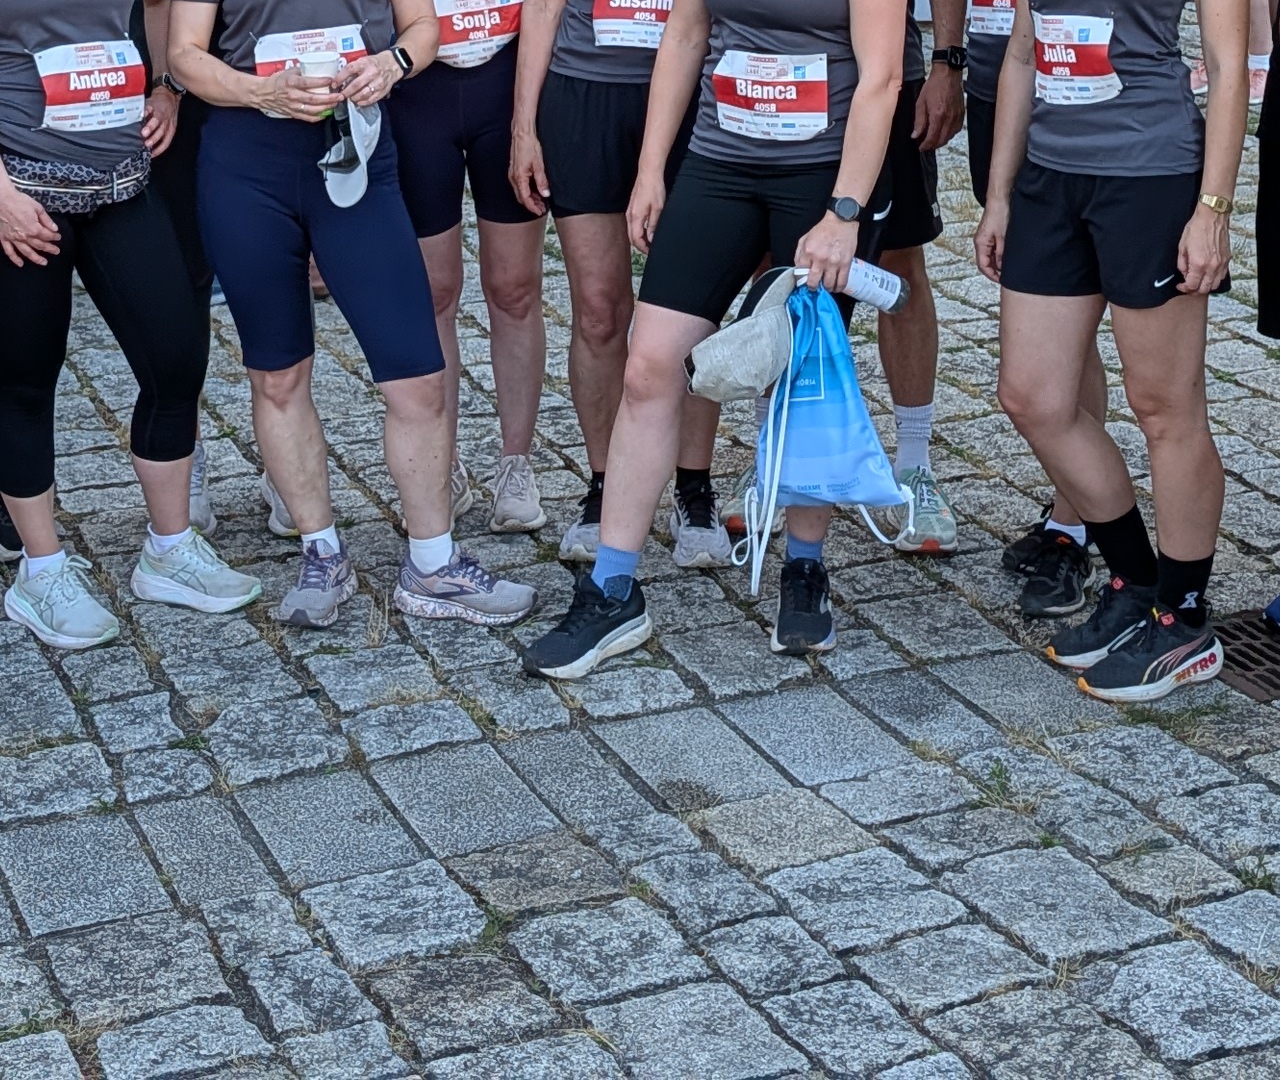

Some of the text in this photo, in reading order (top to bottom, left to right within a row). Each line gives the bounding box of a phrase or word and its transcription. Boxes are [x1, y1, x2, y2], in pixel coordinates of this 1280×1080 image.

[452, 9, 501, 31] Sonja
[634, 11, 656, 22] 4054
[468, 30, 489, 40] 4061
[1043, 44, 1077, 63] Julia
[69, 71, 126, 91] Andrea
[90, 91, 111, 101] 4050
[735, 79, 797, 100] Bianca
[754, 103, 777, 113] 4058
